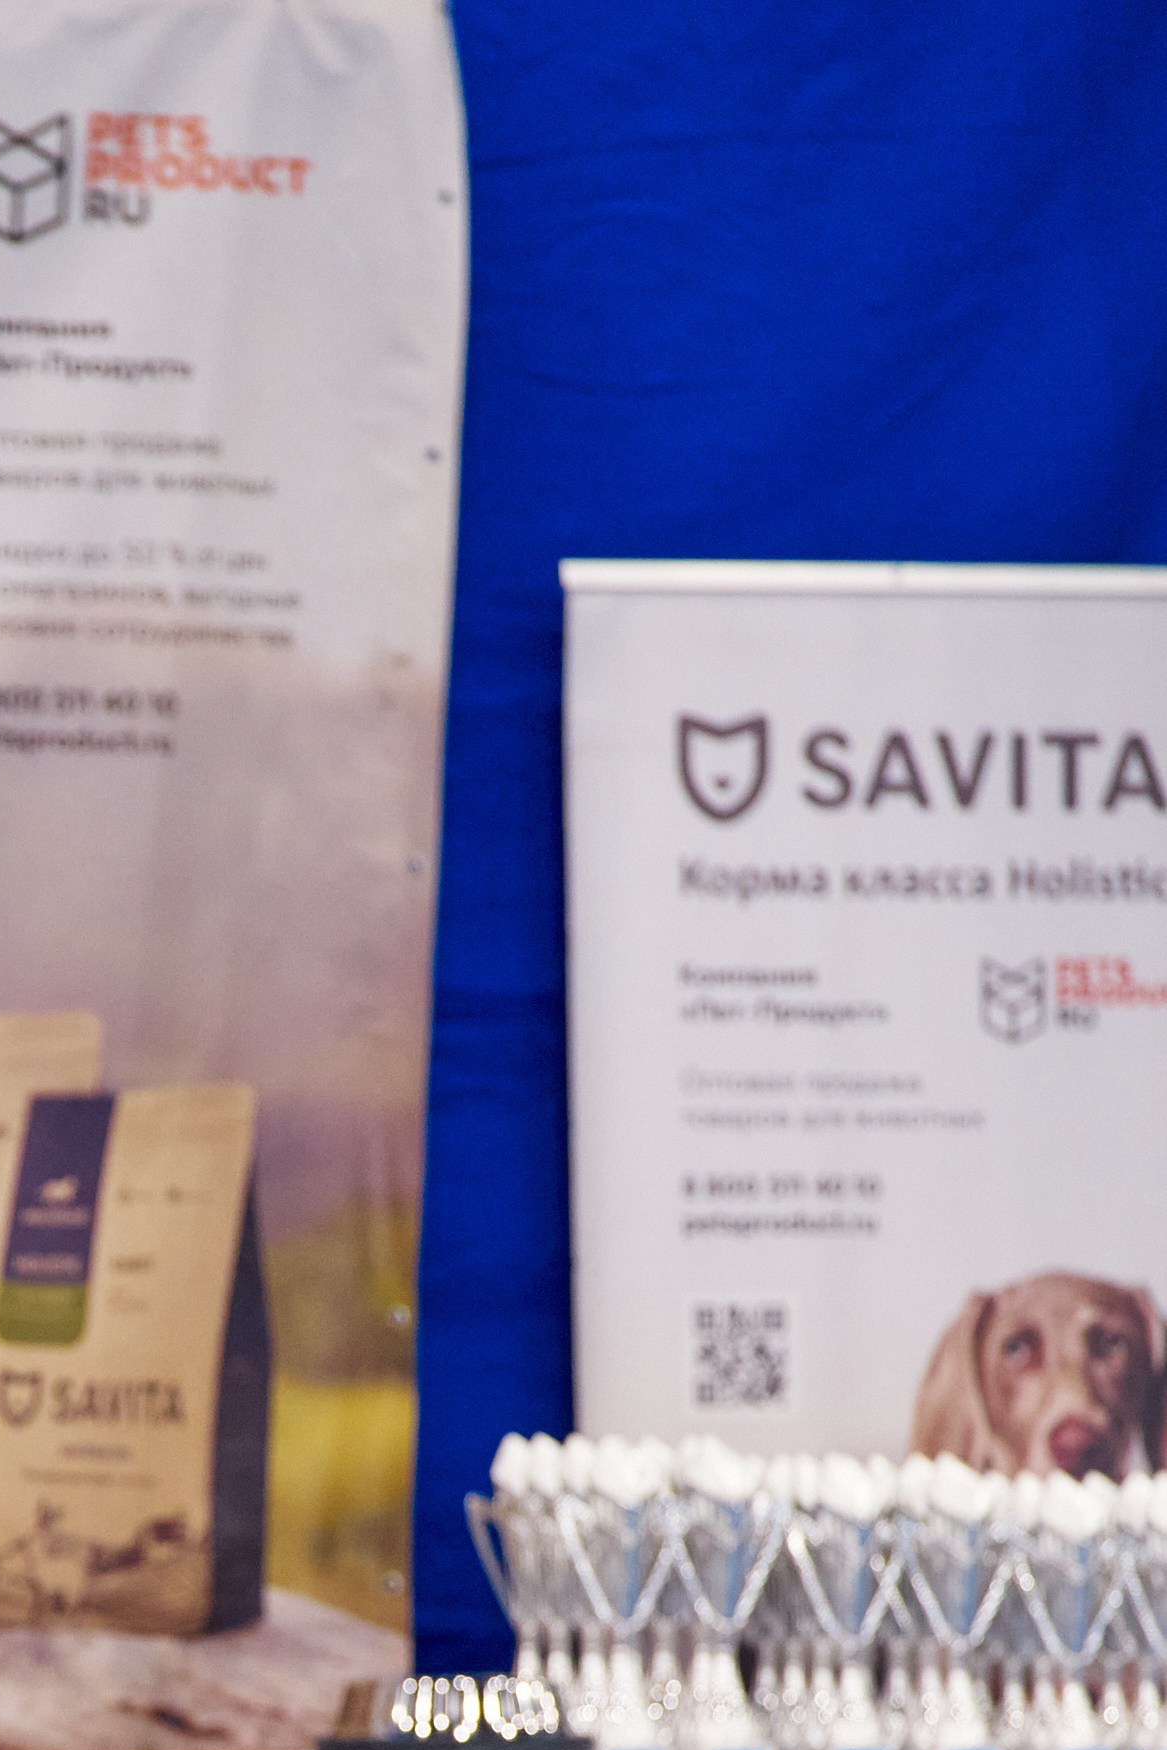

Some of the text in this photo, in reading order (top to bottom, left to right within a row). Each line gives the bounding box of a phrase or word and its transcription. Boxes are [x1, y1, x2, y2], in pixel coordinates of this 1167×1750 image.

[86, 111, 208, 150] PETS
[84, 150, 311, 194] PRODUCT
[83, 190, 151, 226] RU
[802, 727, 1167, 812] SAVITA
[679, 857, 830, 906] Корма
[843, 863, 993, 900] класса
